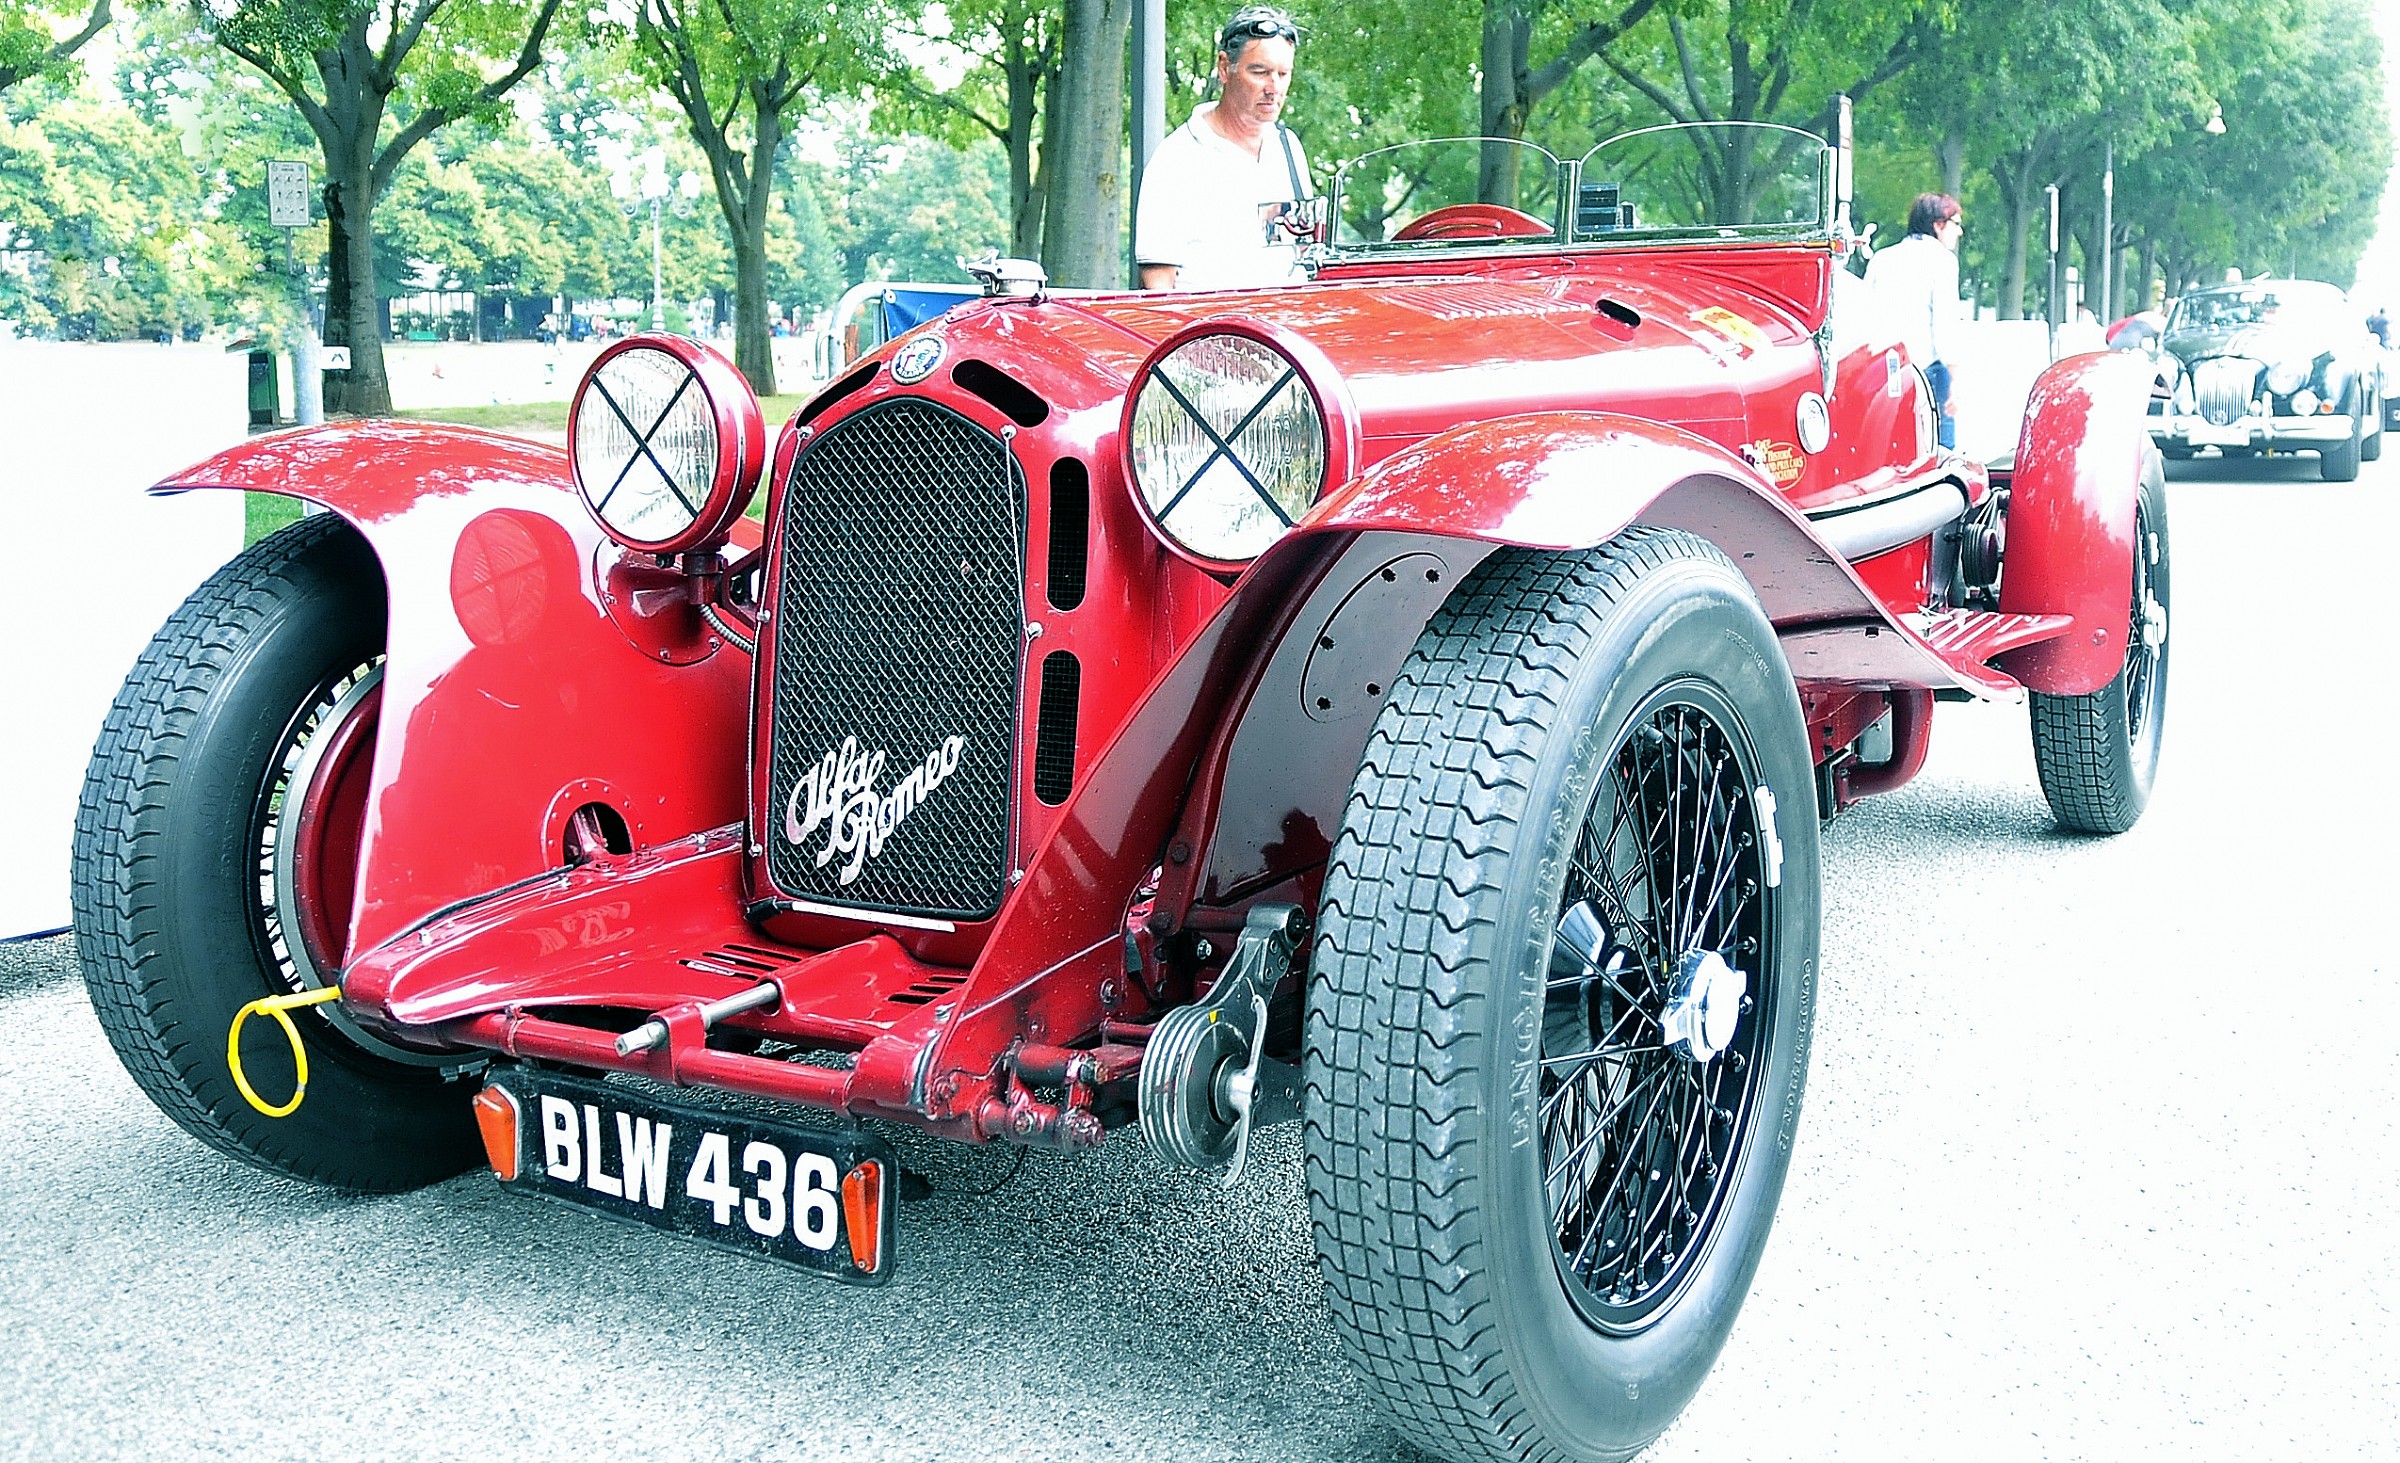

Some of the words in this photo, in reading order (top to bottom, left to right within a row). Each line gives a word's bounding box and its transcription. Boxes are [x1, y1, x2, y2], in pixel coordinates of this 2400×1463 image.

[786, 735, 885, 868] Alfa
[837, 734, 964, 885] Romeo
[540, 1094, 671, 1209] BLW
[686, 1132, 838, 1251] 436
